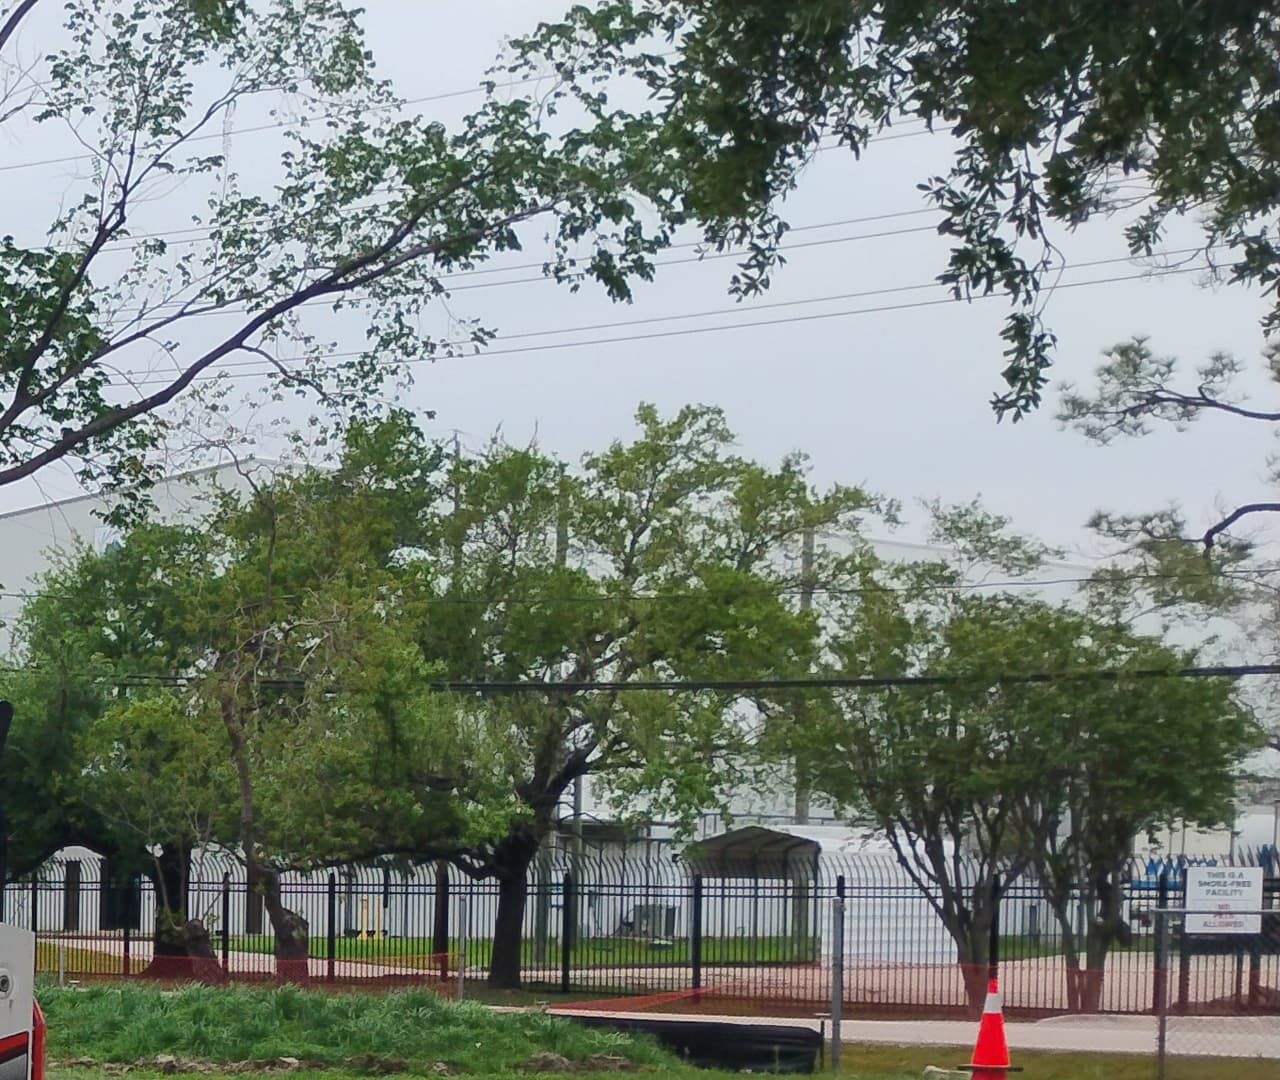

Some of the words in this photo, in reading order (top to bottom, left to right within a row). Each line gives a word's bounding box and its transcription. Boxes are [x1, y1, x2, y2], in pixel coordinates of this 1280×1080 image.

[1207, 871, 1226, 879] THIS
[1238, 871, 1245, 879] A
[1198, 880, 1252, 888] SMOKE-FREE
[1203, 920, 1244, 928] ALLOWED
